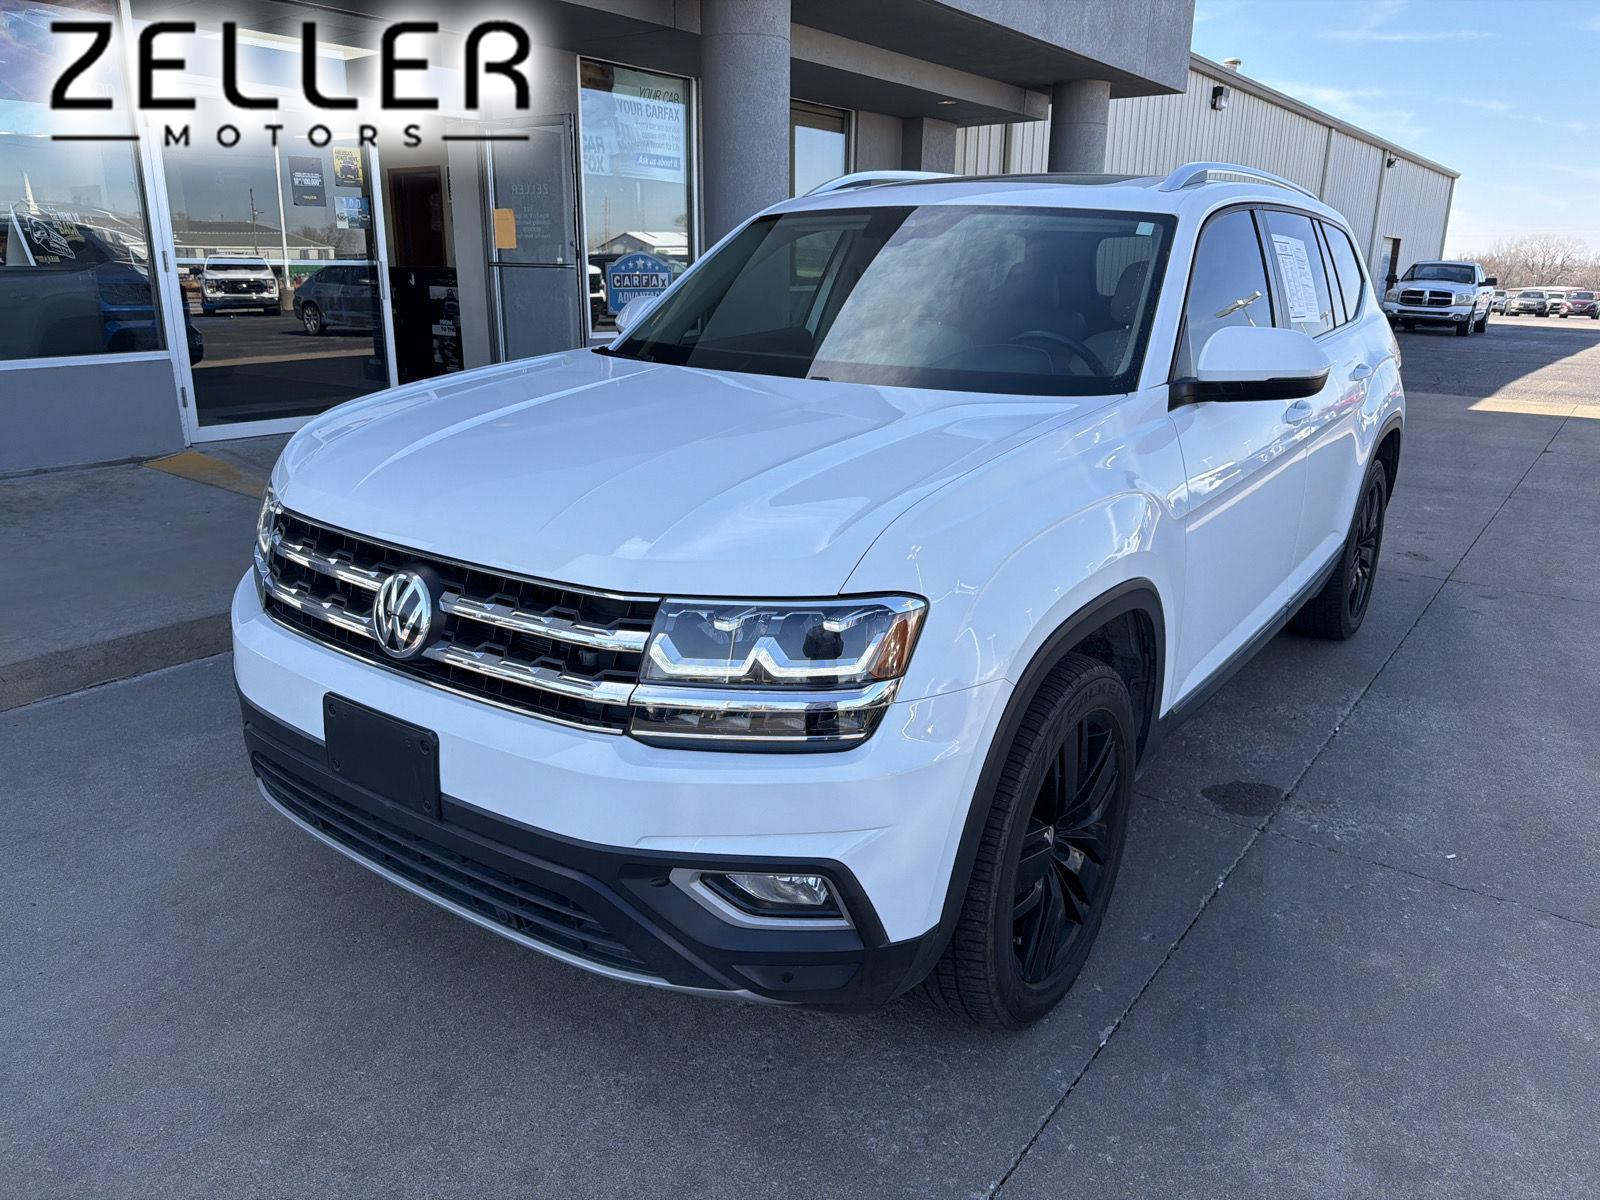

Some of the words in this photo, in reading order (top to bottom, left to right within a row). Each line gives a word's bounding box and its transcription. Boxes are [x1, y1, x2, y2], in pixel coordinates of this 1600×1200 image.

[617, 100, 643, 117] YOUR
[645, 103, 680, 122] CARFAX
[613, 275, 667, 287] CARFAX
